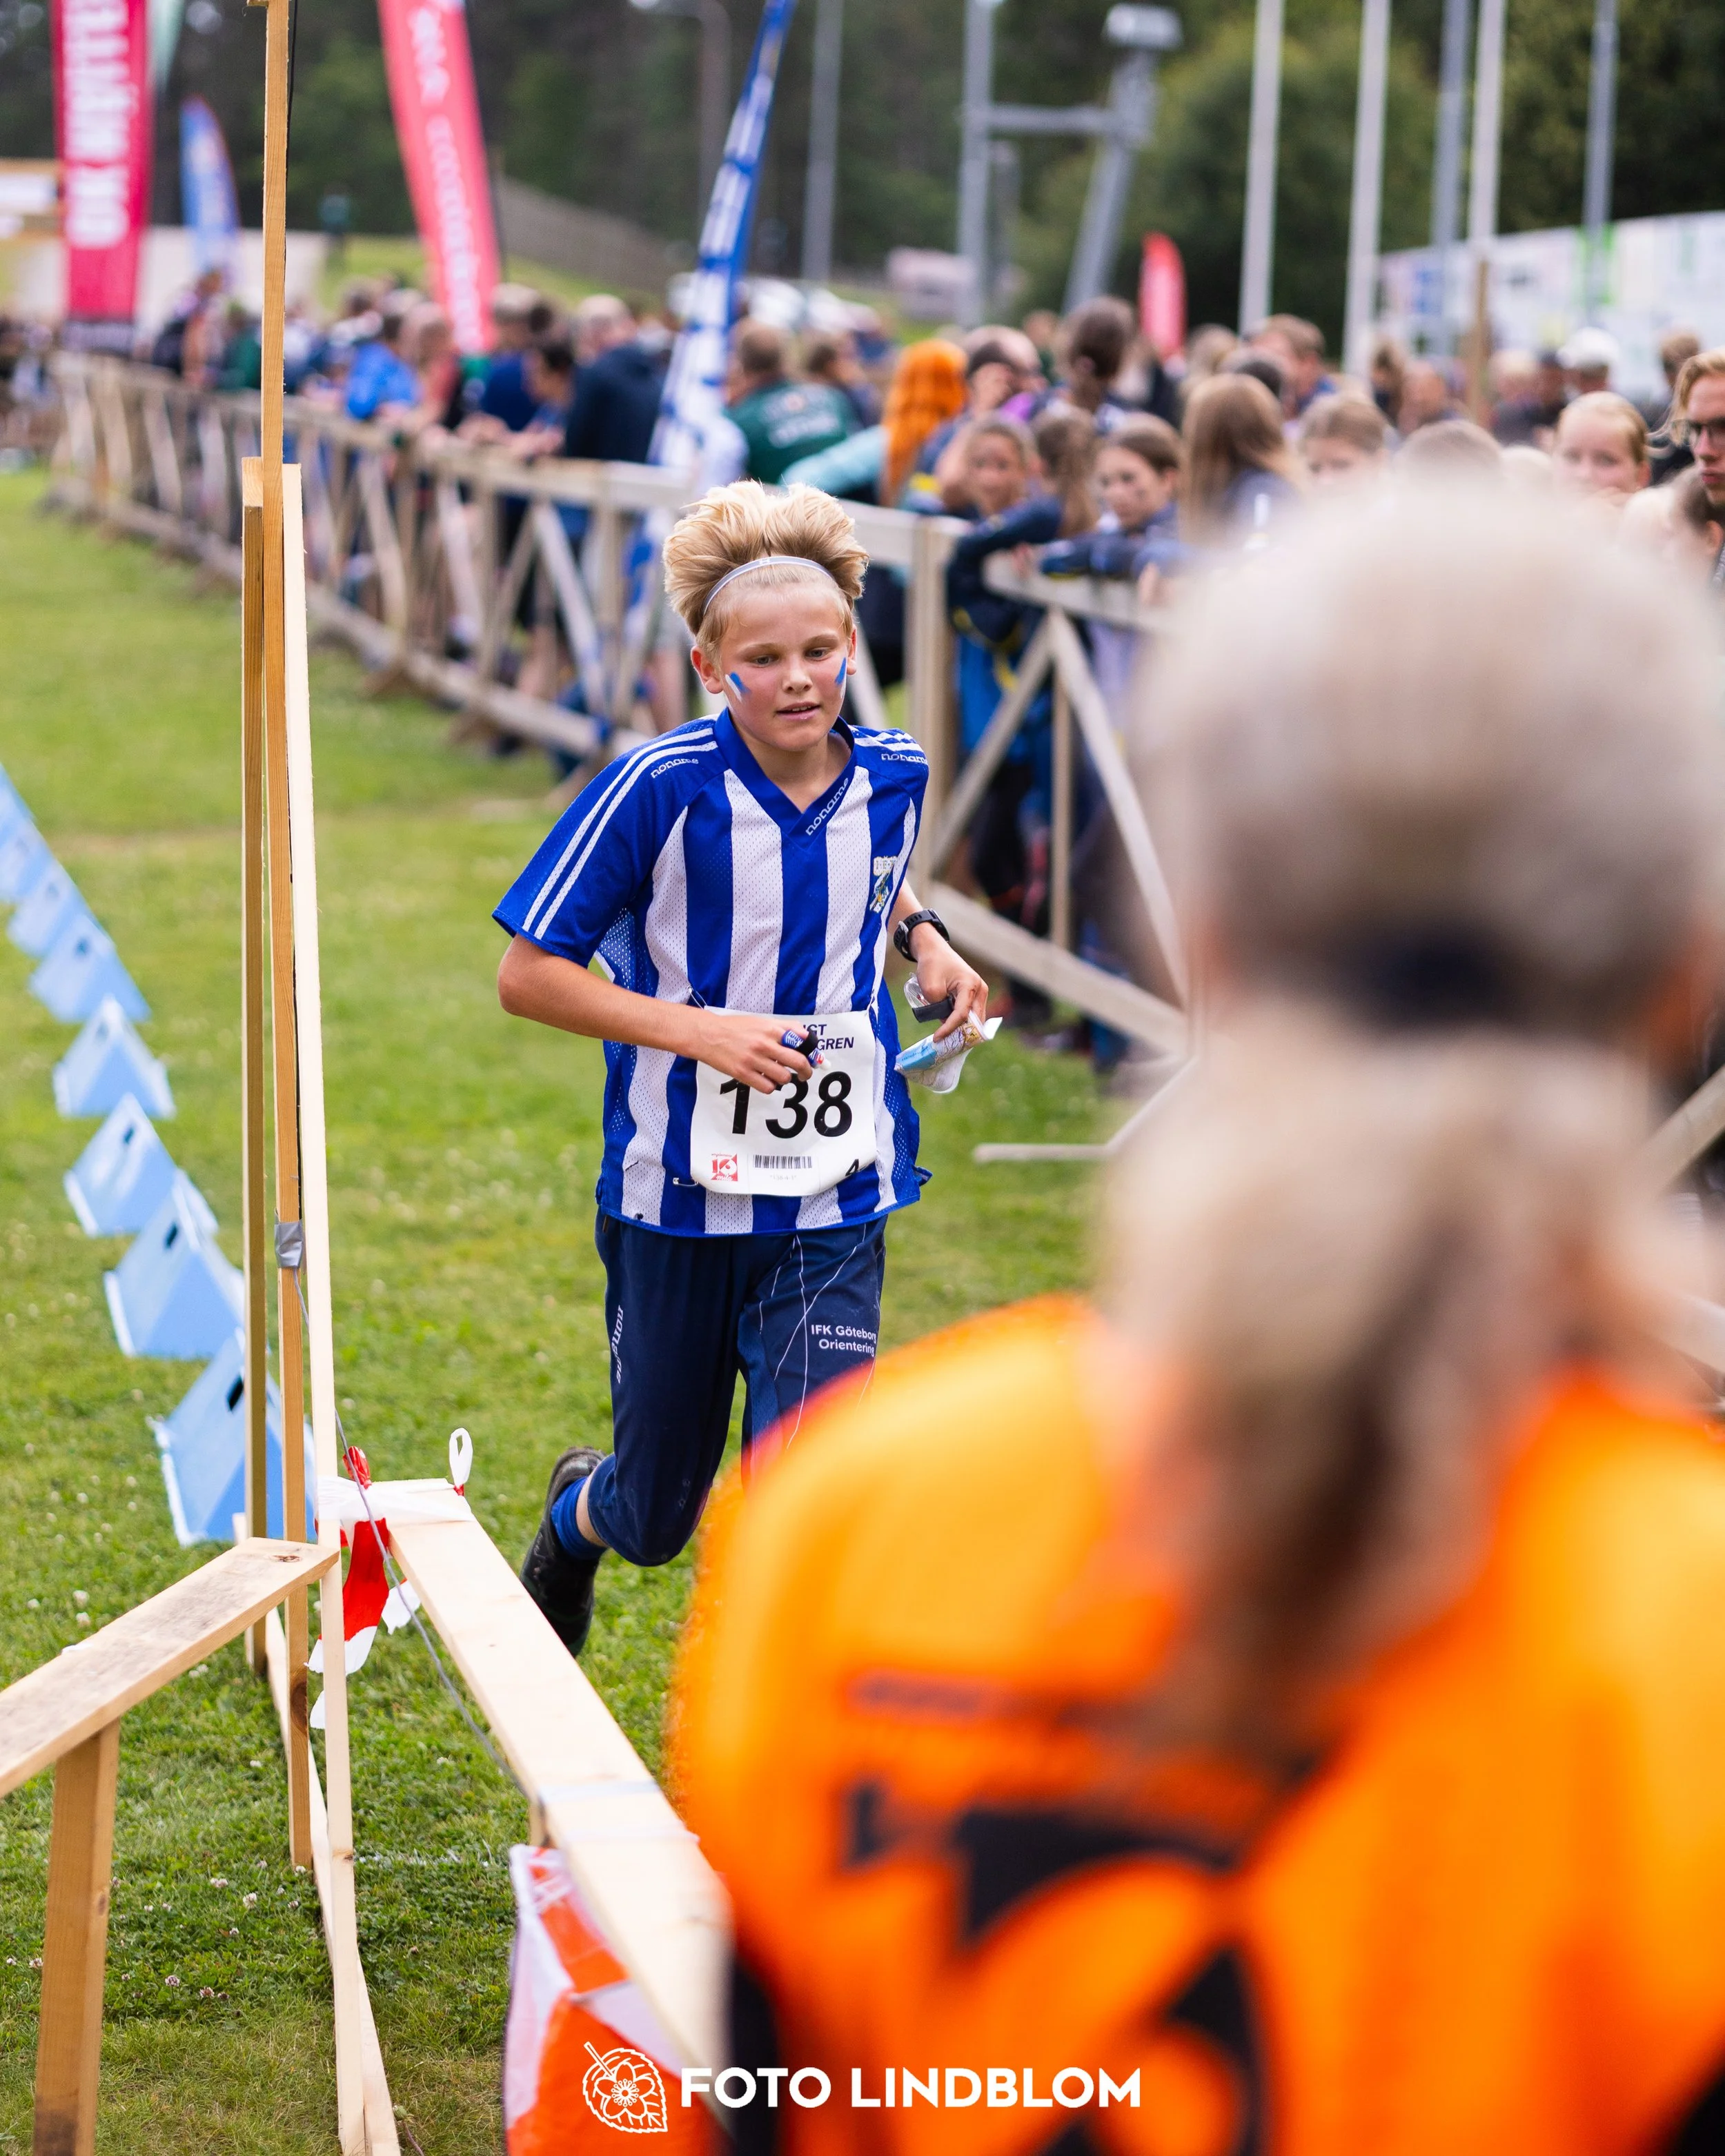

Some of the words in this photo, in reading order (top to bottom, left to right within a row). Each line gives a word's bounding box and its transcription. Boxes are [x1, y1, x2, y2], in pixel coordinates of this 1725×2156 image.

[650, 758, 699, 779] noname
[880, 753, 929, 766] nonam
[805, 778, 849, 835] noname
[816, 1037, 854, 1051] GREN
[719, 1071, 853, 1139] 138
[611, 1304, 624, 1384] noname
[811, 1324, 832, 1335] IFK
[835, 1325, 877, 1345] Göteborg
[818, 1338, 875, 1358] Orientering
